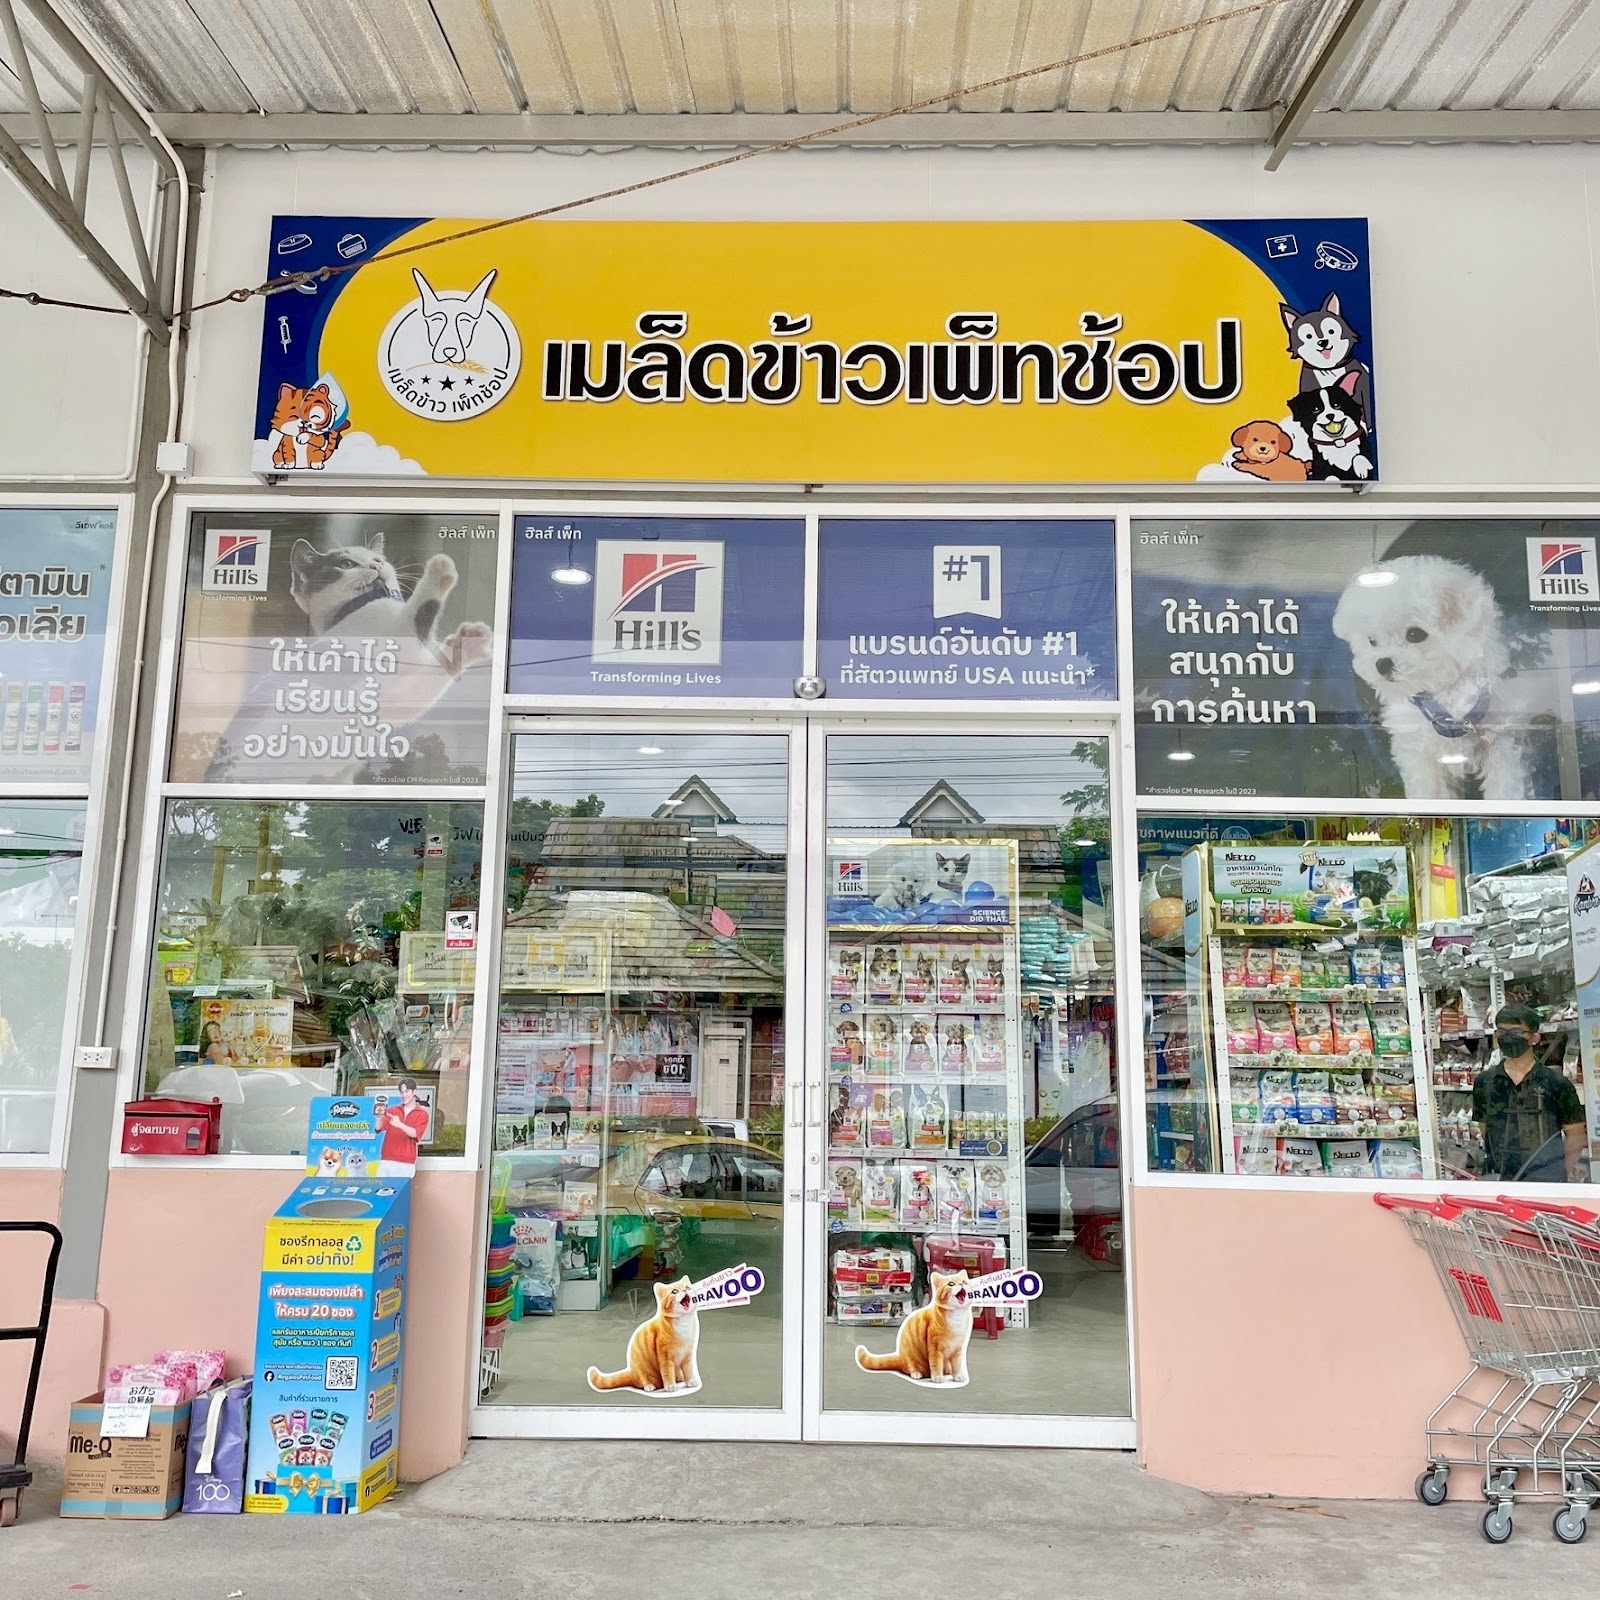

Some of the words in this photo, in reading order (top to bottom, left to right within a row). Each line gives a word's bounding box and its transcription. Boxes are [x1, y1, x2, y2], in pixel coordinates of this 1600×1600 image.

[544, 312, 1241, 404] เมล็ดข้าวเพ็ทช้อป
[388, 368, 446, 413] เมล็ดข้าว
[452, 367, 508, 413] เพ็ทช้อป
[438, 525, 468, 539] ฮิลส์
[471, 524, 496, 539] เพ็ท
[525, 526, 554, 540] ฮิลส์
[557, 525, 582, 540] เพ็ท
[1139, 531, 1170, 545] ฮิลส์
[1173, 530, 1199, 545] เพ็ท
[213, 569, 258, 585] Hill's
[942, 555, 990, 601] #1
[1540, 579, 1589, 595] Hill's
[1161, 598, 1299, 634] ให้เค้าได้
[1529, 605, 1580, 613] Transforming
[613, 620, 702, 651] Hill's
[850, 627, 1032, 656] แบรนด์อันดับ
[1042, 631, 1078, 656] #1
[270, 638, 399, 673] ให้เค้าได้
[840, 660, 958, 685] ที่สัตวแพทย์
[964, 666, 1014, 685] USA
[1169, 642, 1294, 688] สนุกกับ
[590, 671, 681, 687] Transforming
[686, 672, 722, 685] Lives
[275, 677, 379, 727] เรียนรู้
[1151, 687, 1318, 724] การค้นหา
[243, 718, 410, 758] อย่างมั่นใจ
[407, 776, 418, 784] CM
[419, 776, 448, 784] Research
[1193, 787, 1224, 795] Research
[838, 882, 864, 892] Hill's
[131, 1122, 179, 1137] ตู้จดหมาย
[279, 1235, 343, 1247] ซองรีกาลอส
[522, 1236, 547, 1245] CANIN
[282, 1253, 303, 1266] มีค่า
[306, 1248, 354, 1266] อย่าทิ้ง!
[269, 1284, 363, 1299] เพียงสะสมซองเปล่า
[692, 1269, 762, 1304] BRAVOO
[967, 1273, 1040, 1299] BRAVOO
[276, 1302, 309, 1317] ให้ครบ
[311, 1304, 329, 1317] 20
[331, 1307, 354, 1317] ซอง
[196, 1484, 230, 1500] 100
